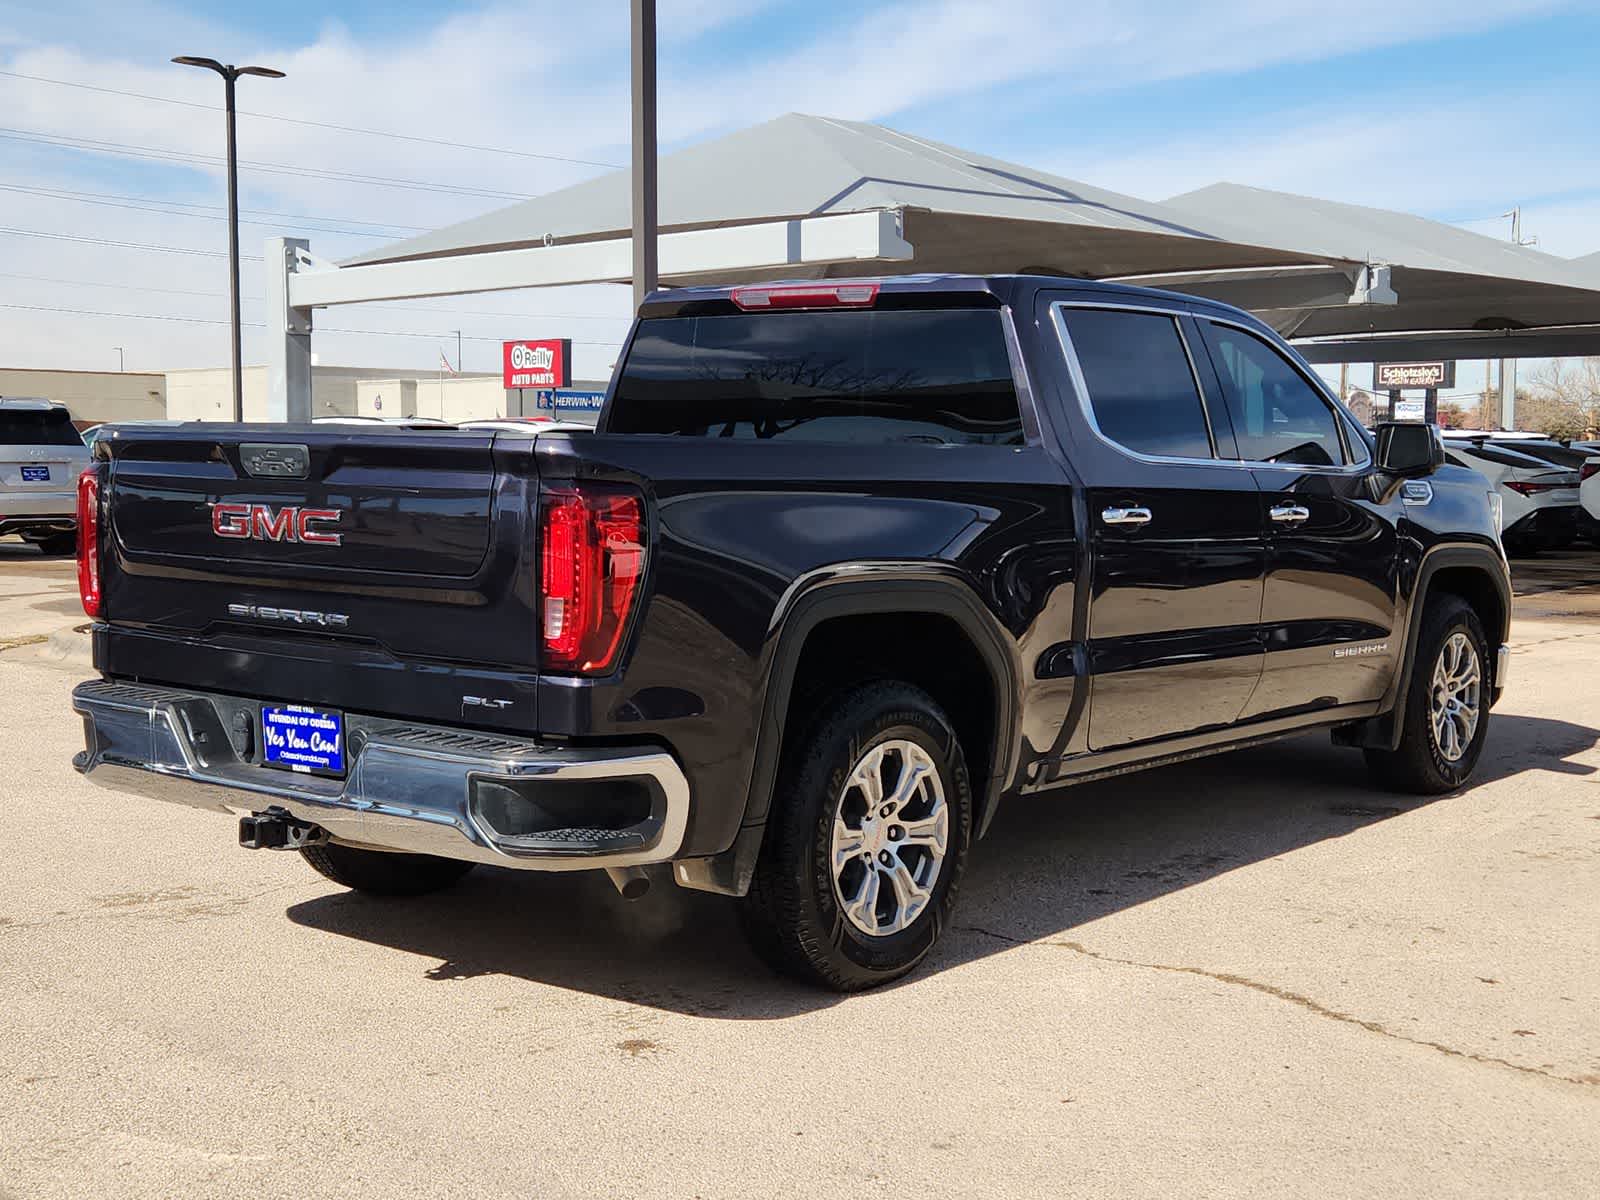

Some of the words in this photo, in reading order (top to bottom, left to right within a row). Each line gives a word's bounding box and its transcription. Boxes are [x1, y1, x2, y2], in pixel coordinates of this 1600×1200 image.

[512, 345, 554, 370] O'Reilly
[511, 374, 530, 385] AUTO
[531, 373, 555, 384] PARTS
[1383, 366, 1440, 378] Schlotzsky's
[211, 503, 344, 547] GMC
[228, 603, 350, 627] SIERRA
[1333, 643, 1388, 658] SIERRA
[463, 695, 514, 709] SLT
[299, 716, 309, 726] OF
[265, 726, 285, 748] Yes
[286, 728, 309, 749] You
[310, 731, 340, 755] Can!
